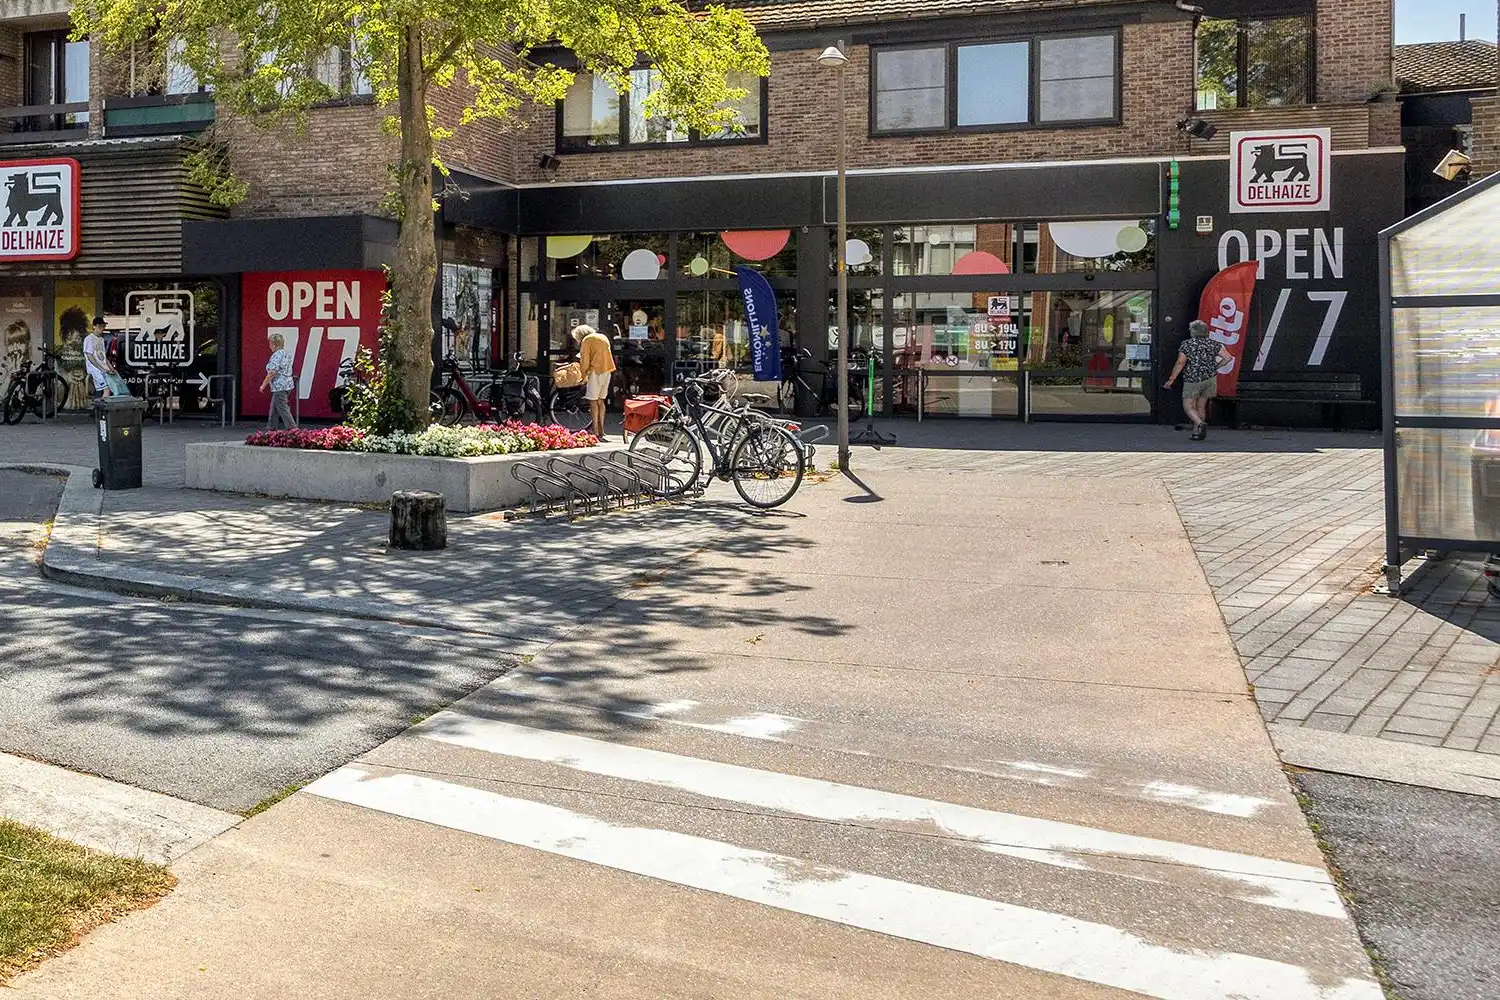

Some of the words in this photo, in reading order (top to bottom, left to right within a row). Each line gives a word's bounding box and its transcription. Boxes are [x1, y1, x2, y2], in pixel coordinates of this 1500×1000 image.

[1248, 183, 1311, 200] DELHAIZE
[2, 229, 65, 250] DELHAIZE
[1217, 227, 1344, 280] OPEN
[267, 280, 360, 320] OPEN
[974, 324, 987, 333] 8U
[998, 323, 1017, 333] 19U
[1253, 288, 1349, 371] /7
[134, 343, 186, 360] DELHAIZE
[974, 340, 988, 350] 8U
[998, 340, 1017, 350] 17U
